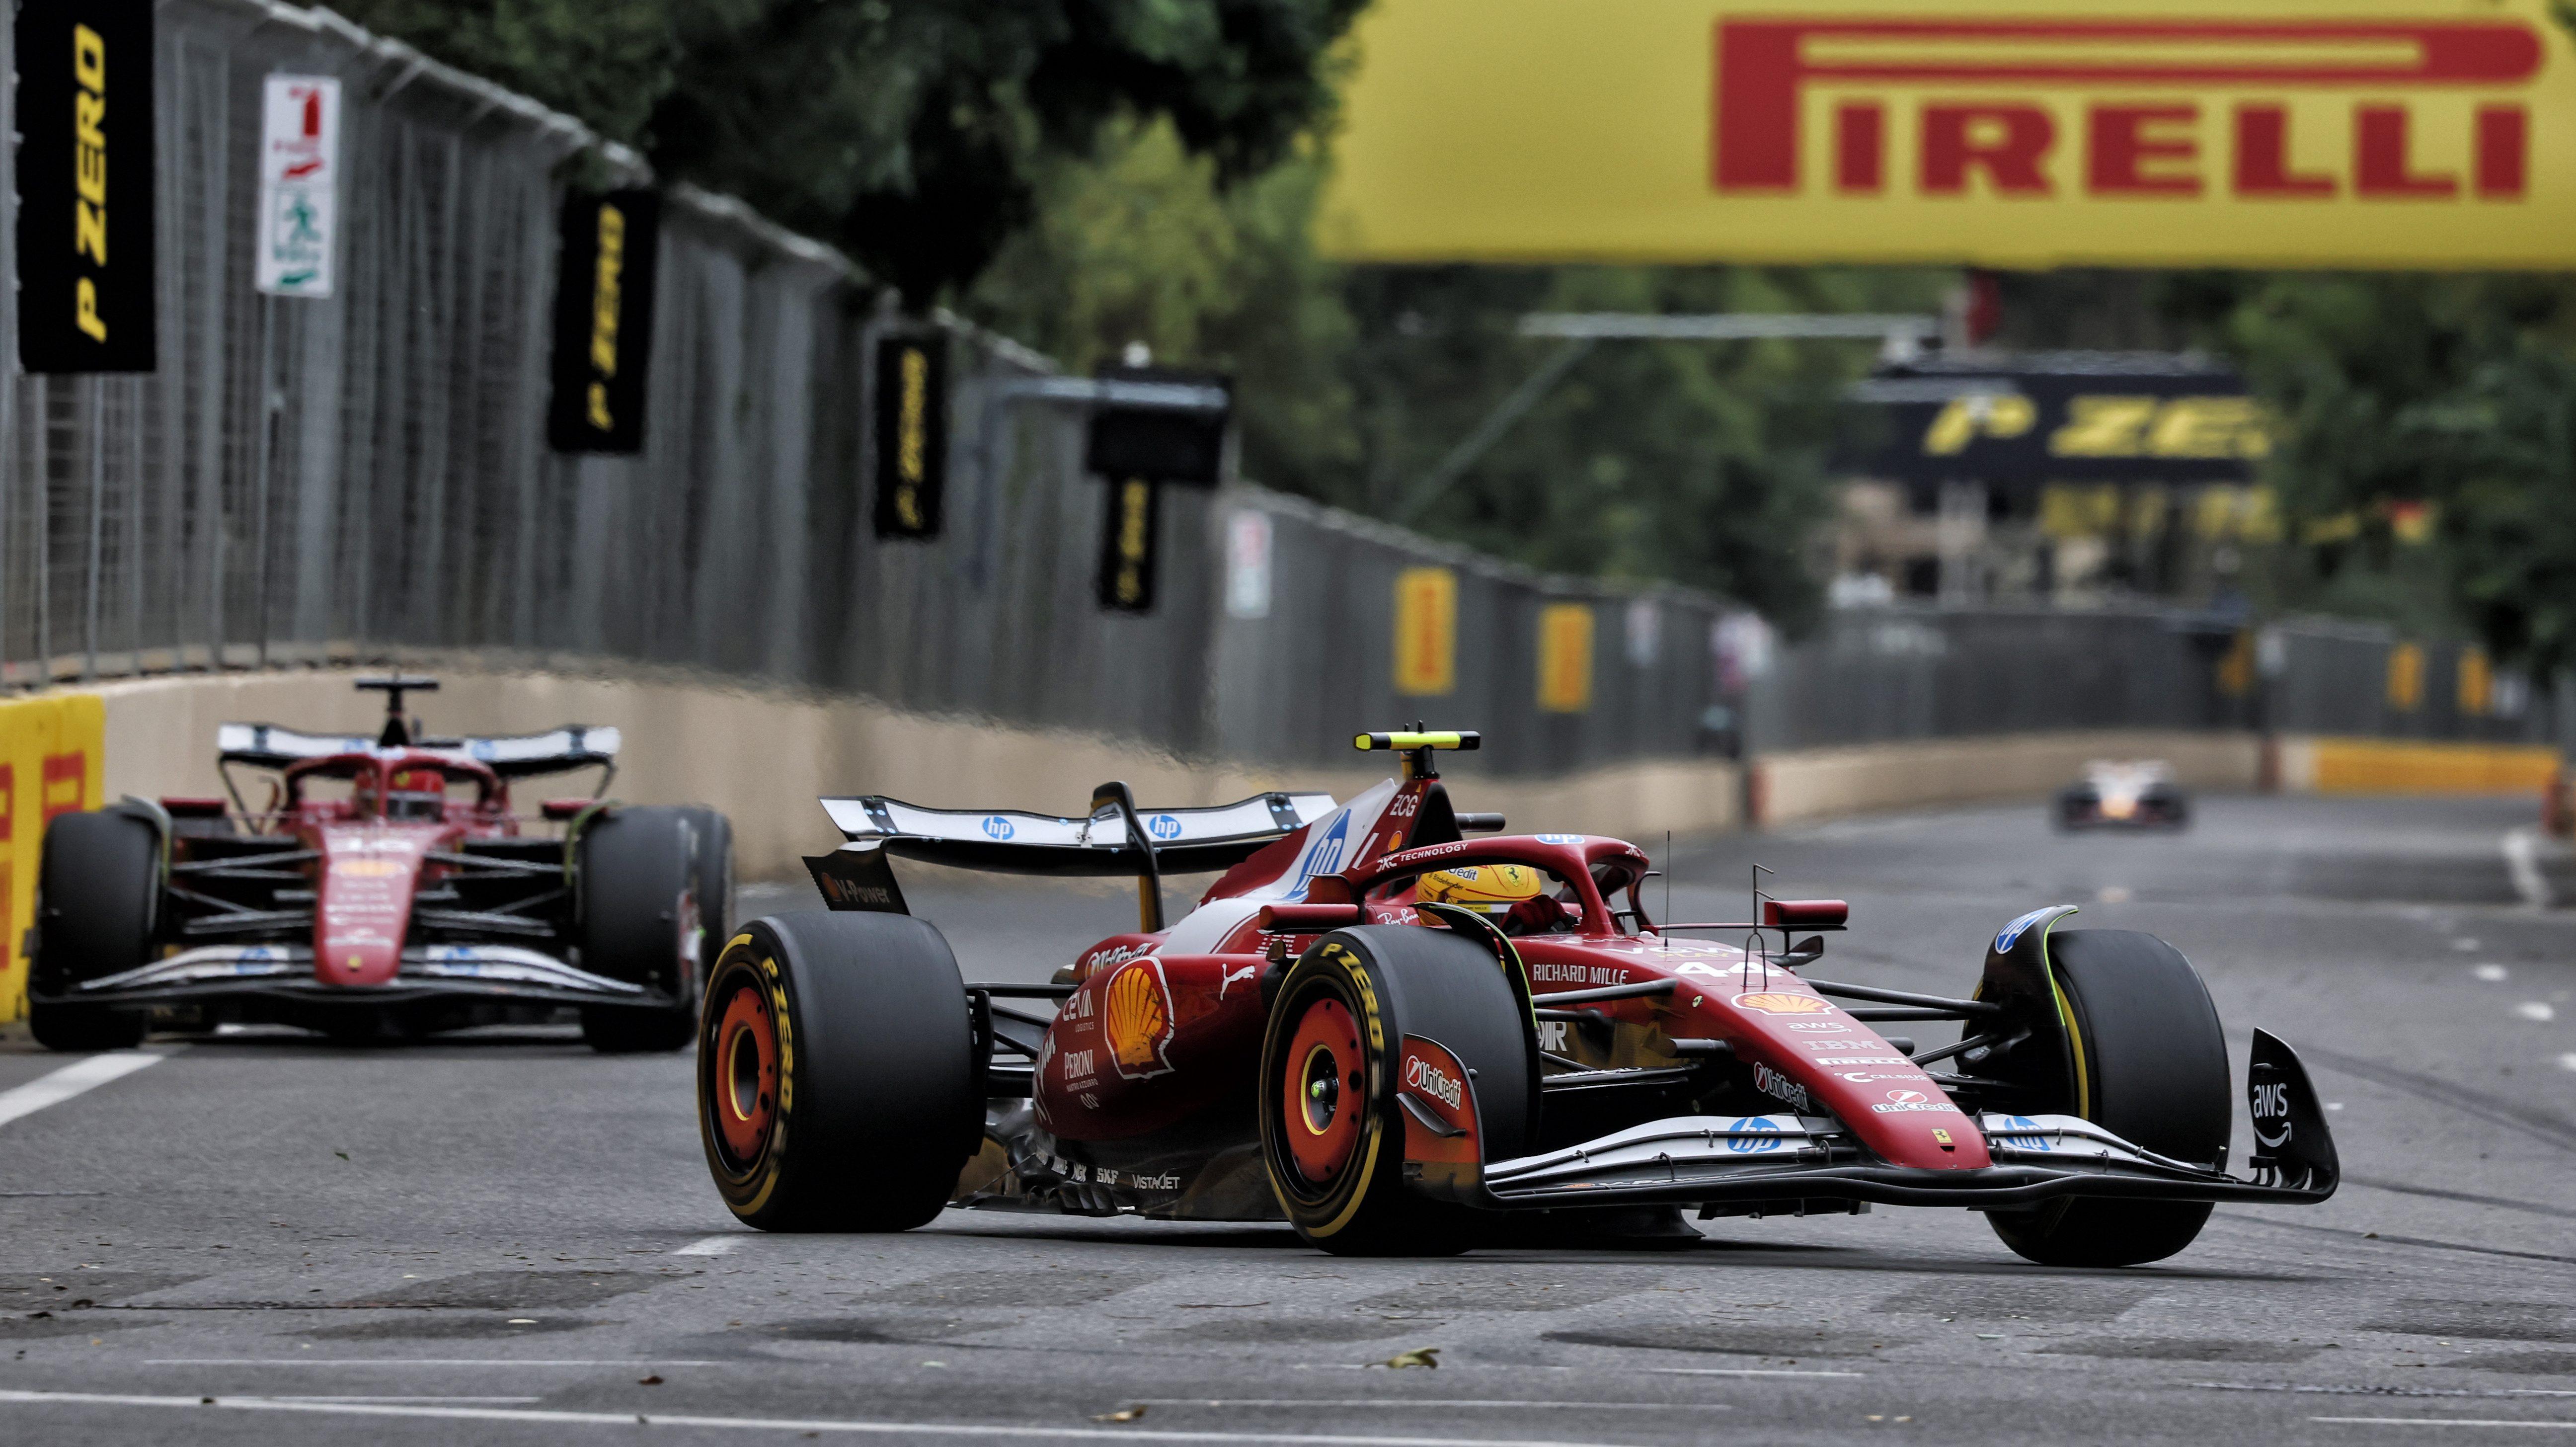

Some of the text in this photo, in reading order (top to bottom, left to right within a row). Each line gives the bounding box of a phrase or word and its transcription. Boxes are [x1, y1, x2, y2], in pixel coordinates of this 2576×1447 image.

[1715, 18, 2543, 197] PIRELLI
[75, 23, 107, 343] P ZERO
[1390, 795, 1418, 817] ZCG
[987, 815, 1011, 840] hp
[1154, 814, 1177, 839] hp
[1401, 843, 1468, 862] TECHNOLOGY
[1533, 964, 1630, 985] RICHARD MILLE
[1674, 962, 1785, 977] 44
[1320, 943, 1385, 1052] P ZERO
[762, 956, 793, 1114] P ZERO
[1801, 1040, 1884, 1050] IBM
[1064, 1049, 1094, 1080] PERONI
[1815, 1057, 1909, 1065] PIRELLI
[1419, 1061, 1461, 1110] UniCredit
[1872, 1102, 1963, 1113] UniCredit
[2254, 1083, 2288, 1118] aws
[1733, 1117, 1777, 1153] hp
[1096, 1167, 1118, 1185] SKF
